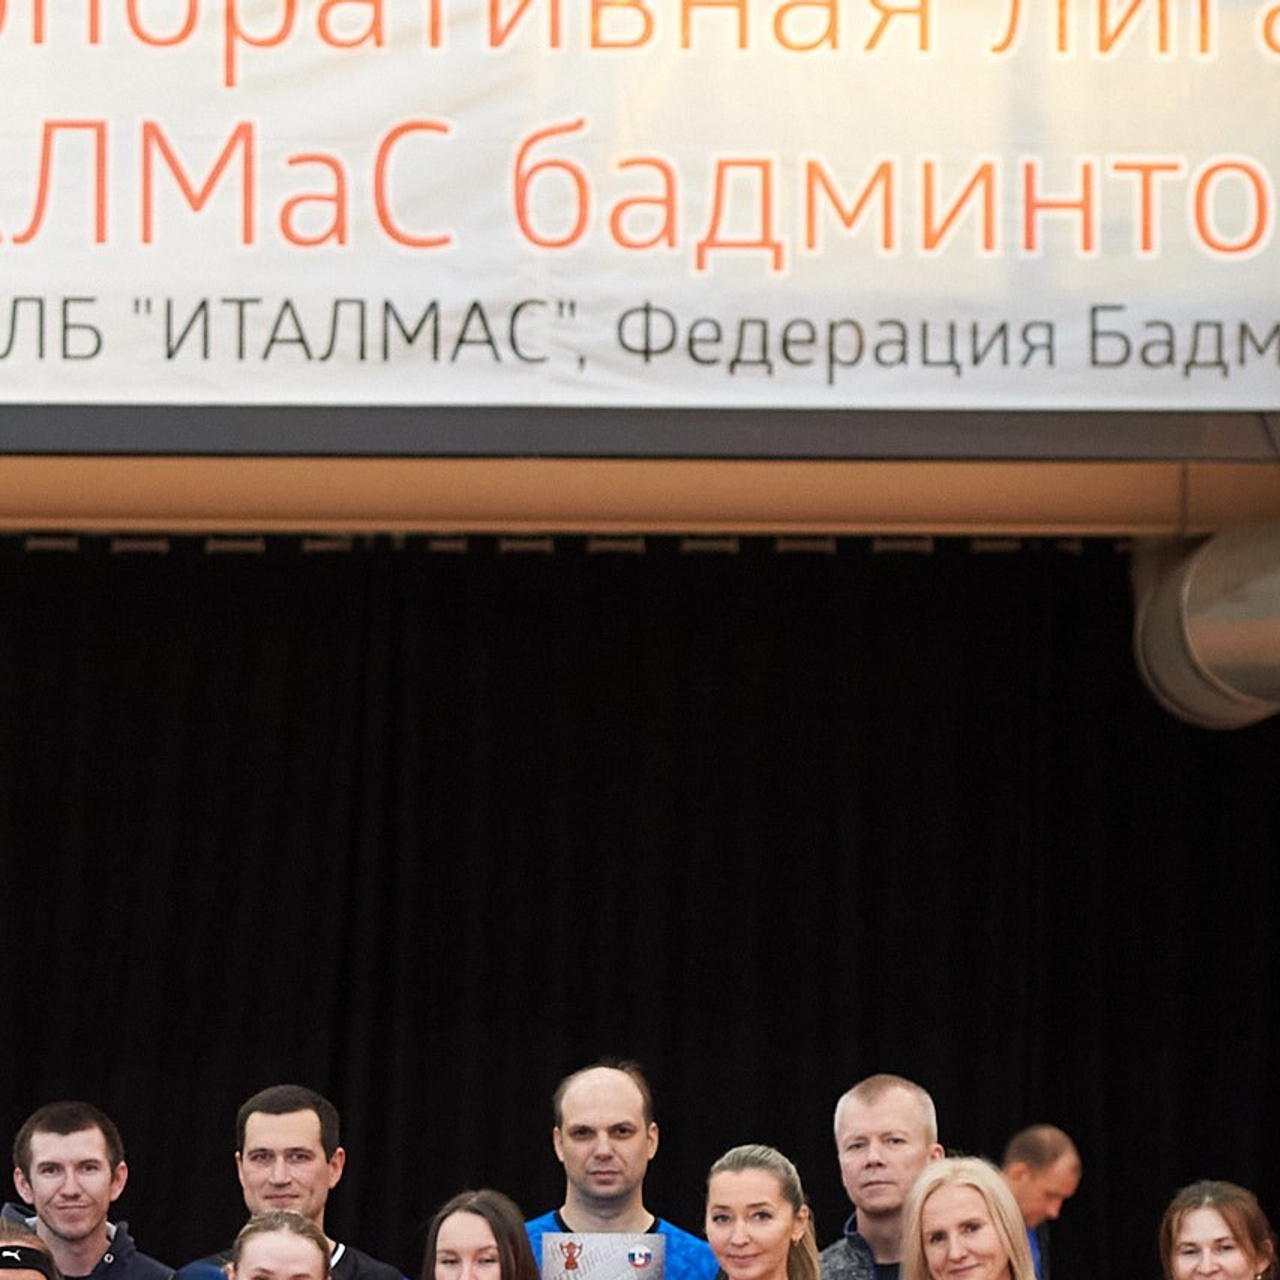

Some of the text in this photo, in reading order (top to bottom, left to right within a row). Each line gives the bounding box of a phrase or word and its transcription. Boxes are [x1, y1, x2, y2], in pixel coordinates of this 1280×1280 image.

[991, 0, 1280, 54] лиг
[513, 119, 1268, 270] бадминто
[616, 301, 1054, 384] Федерация
